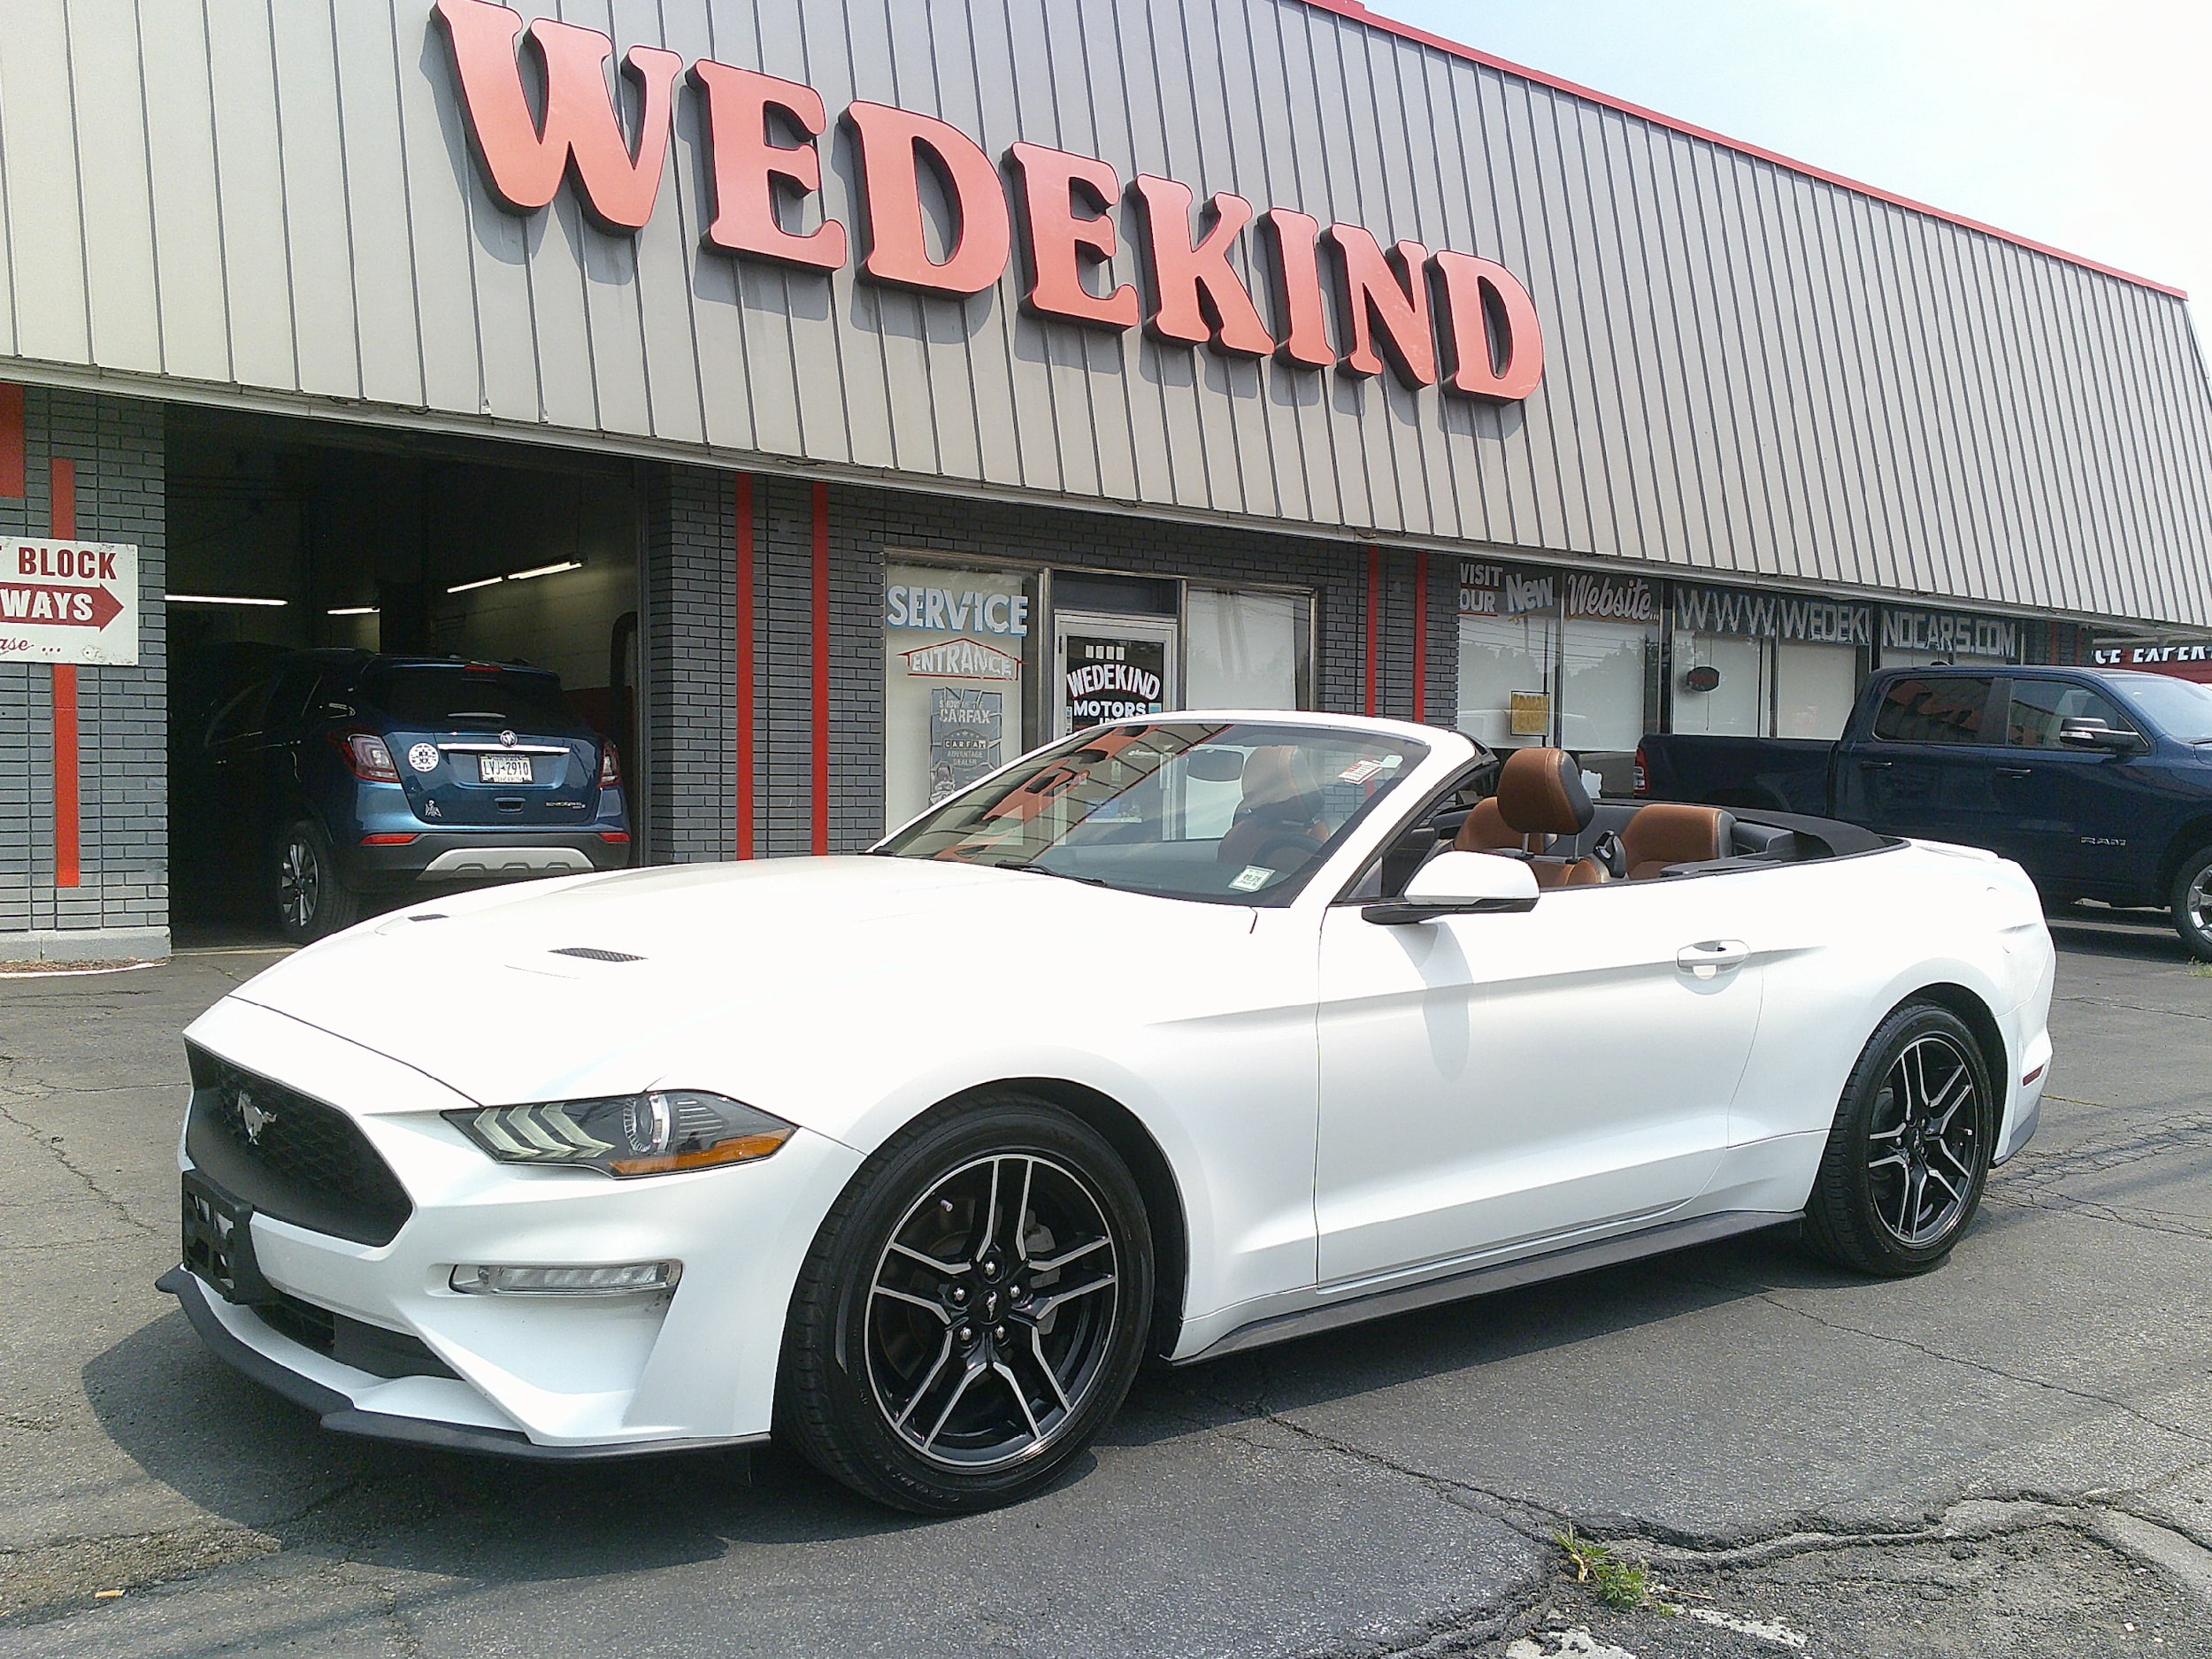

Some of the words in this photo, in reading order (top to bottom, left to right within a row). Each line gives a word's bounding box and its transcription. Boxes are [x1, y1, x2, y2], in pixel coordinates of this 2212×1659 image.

[435, 0, 1545, 403] WEDEKIND
[18, 546, 117, 580] BLOCK
[1460, 563, 1503, 587] VISIT
[0, 588, 93, 621] WAYS
[887, 585, 1029, 636] SERVICE
[1460, 588, 1495, 612] OUR
[911, 642, 1011, 676] ENTRANCE
[1066, 664, 1160, 701] WEDEKIND
[939, 709, 990, 724] CARFAX
[1073, 700, 1147, 718] MOTORS
[945, 740, 987, 749] CARFAX
[947, 749, 983, 759] ADVANTAGE
